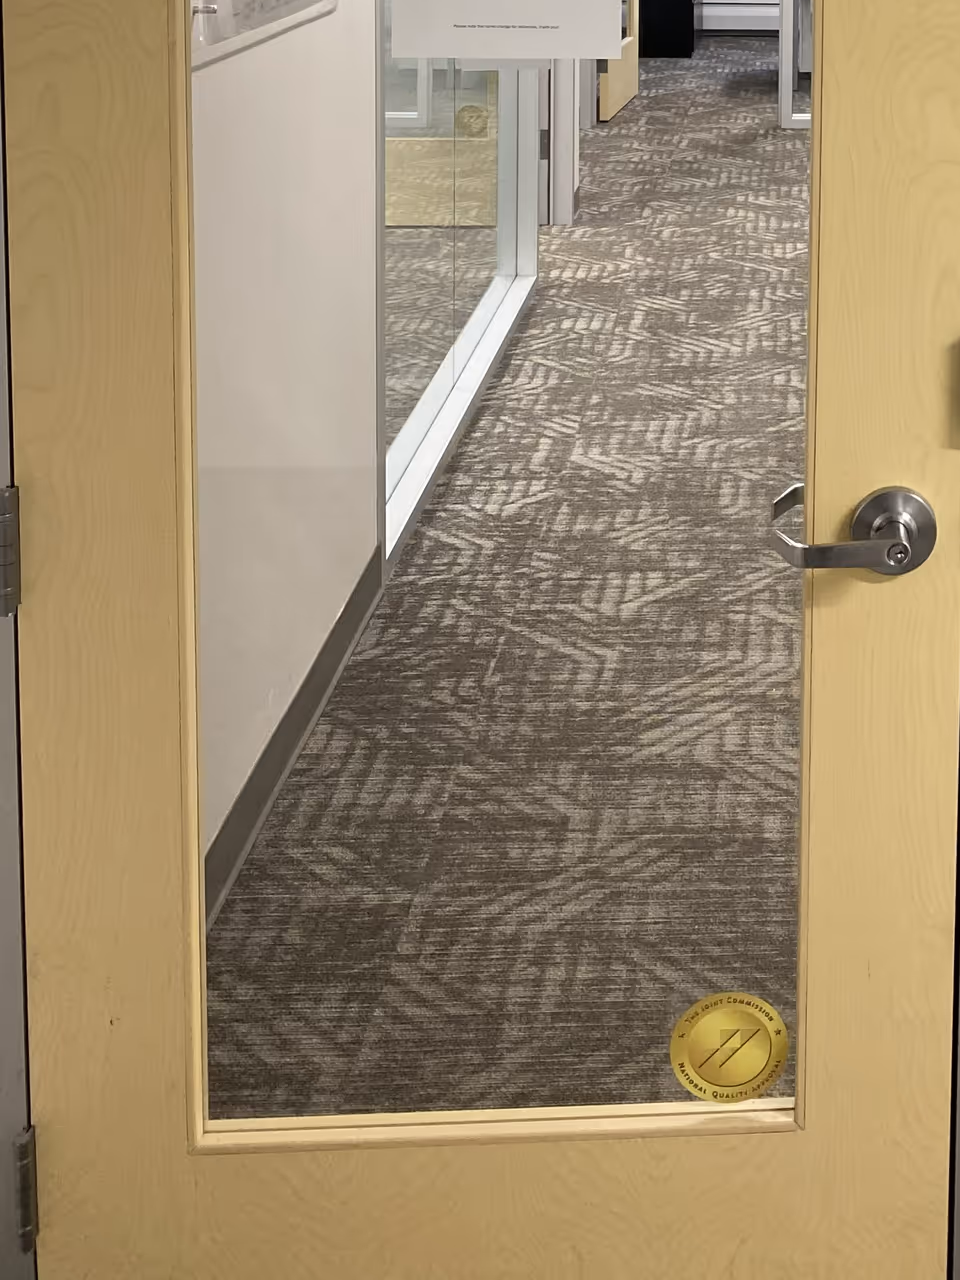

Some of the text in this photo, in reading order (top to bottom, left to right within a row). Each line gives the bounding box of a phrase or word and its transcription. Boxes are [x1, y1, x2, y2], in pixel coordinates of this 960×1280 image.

[702, 998, 724, 1012] JOINT
[726, 996, 775, 1022] COMMISSION
[677, 1061, 708, 1095] NATIONAL
[711, 1090, 748, 1100] QUALITY
